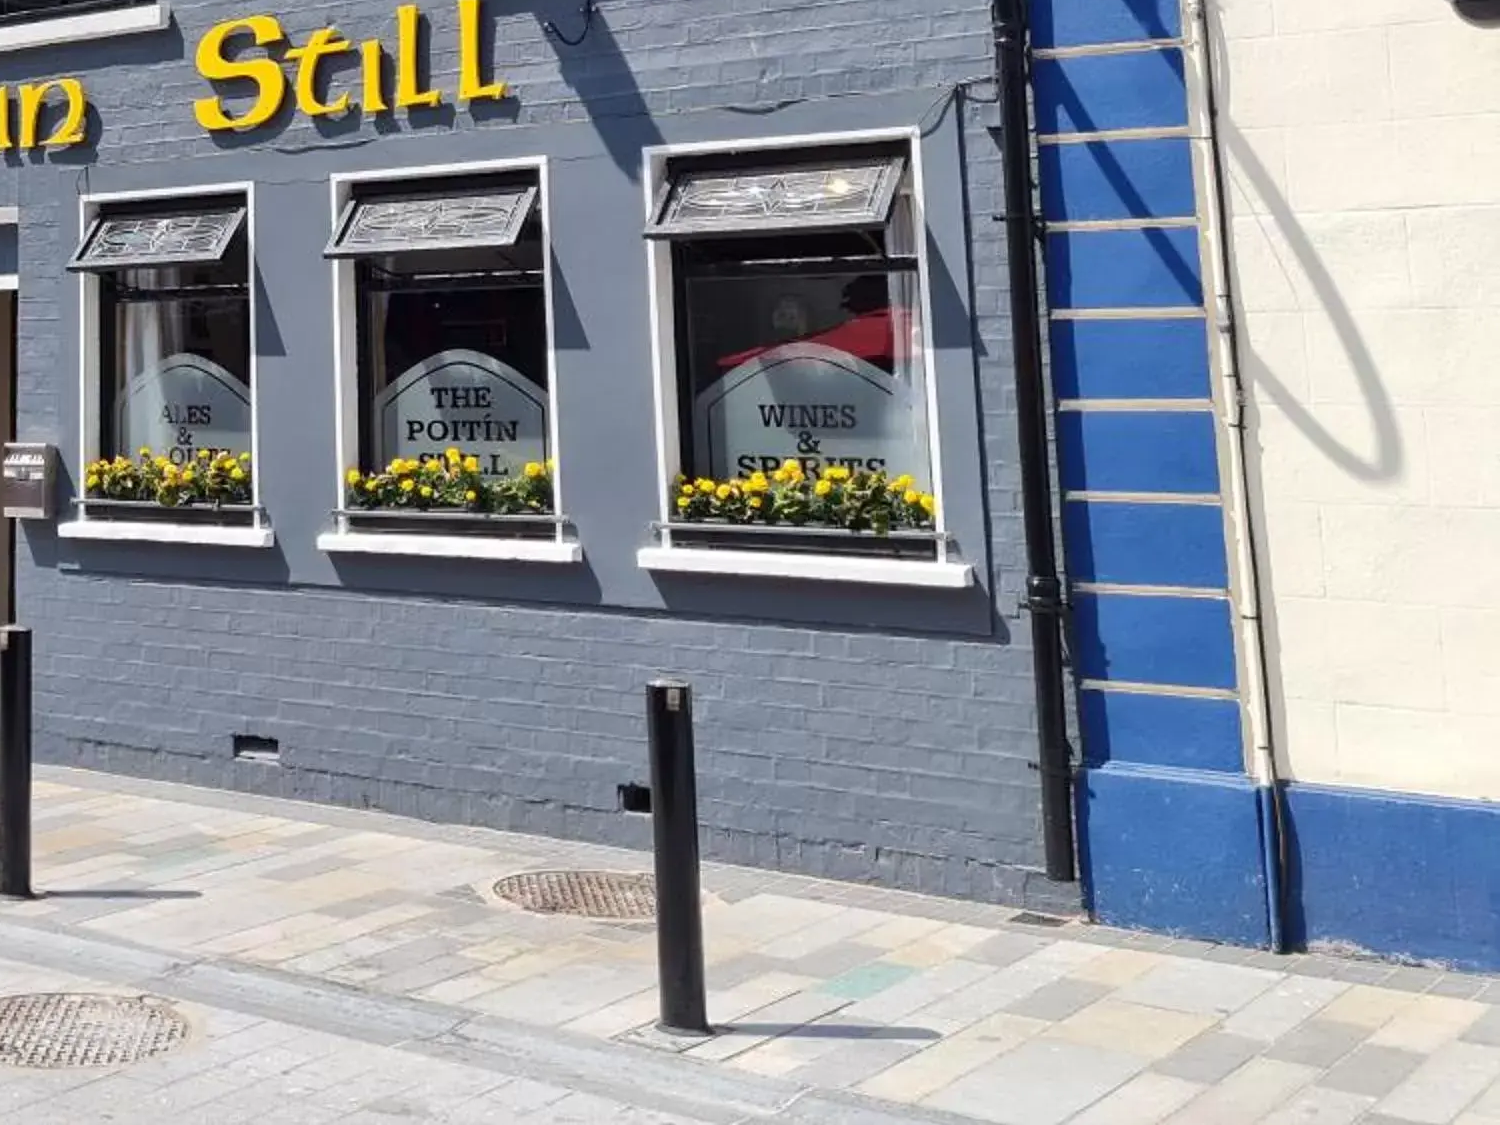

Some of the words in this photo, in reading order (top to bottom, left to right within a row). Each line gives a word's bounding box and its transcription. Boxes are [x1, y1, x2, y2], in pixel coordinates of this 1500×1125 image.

[431, 386, 492, 409] THE
[406, 413, 519, 442] POITÍN
[758, 404, 857, 429] WINES
[177, 426, 193, 446] &
[797, 430, 822, 454] &
